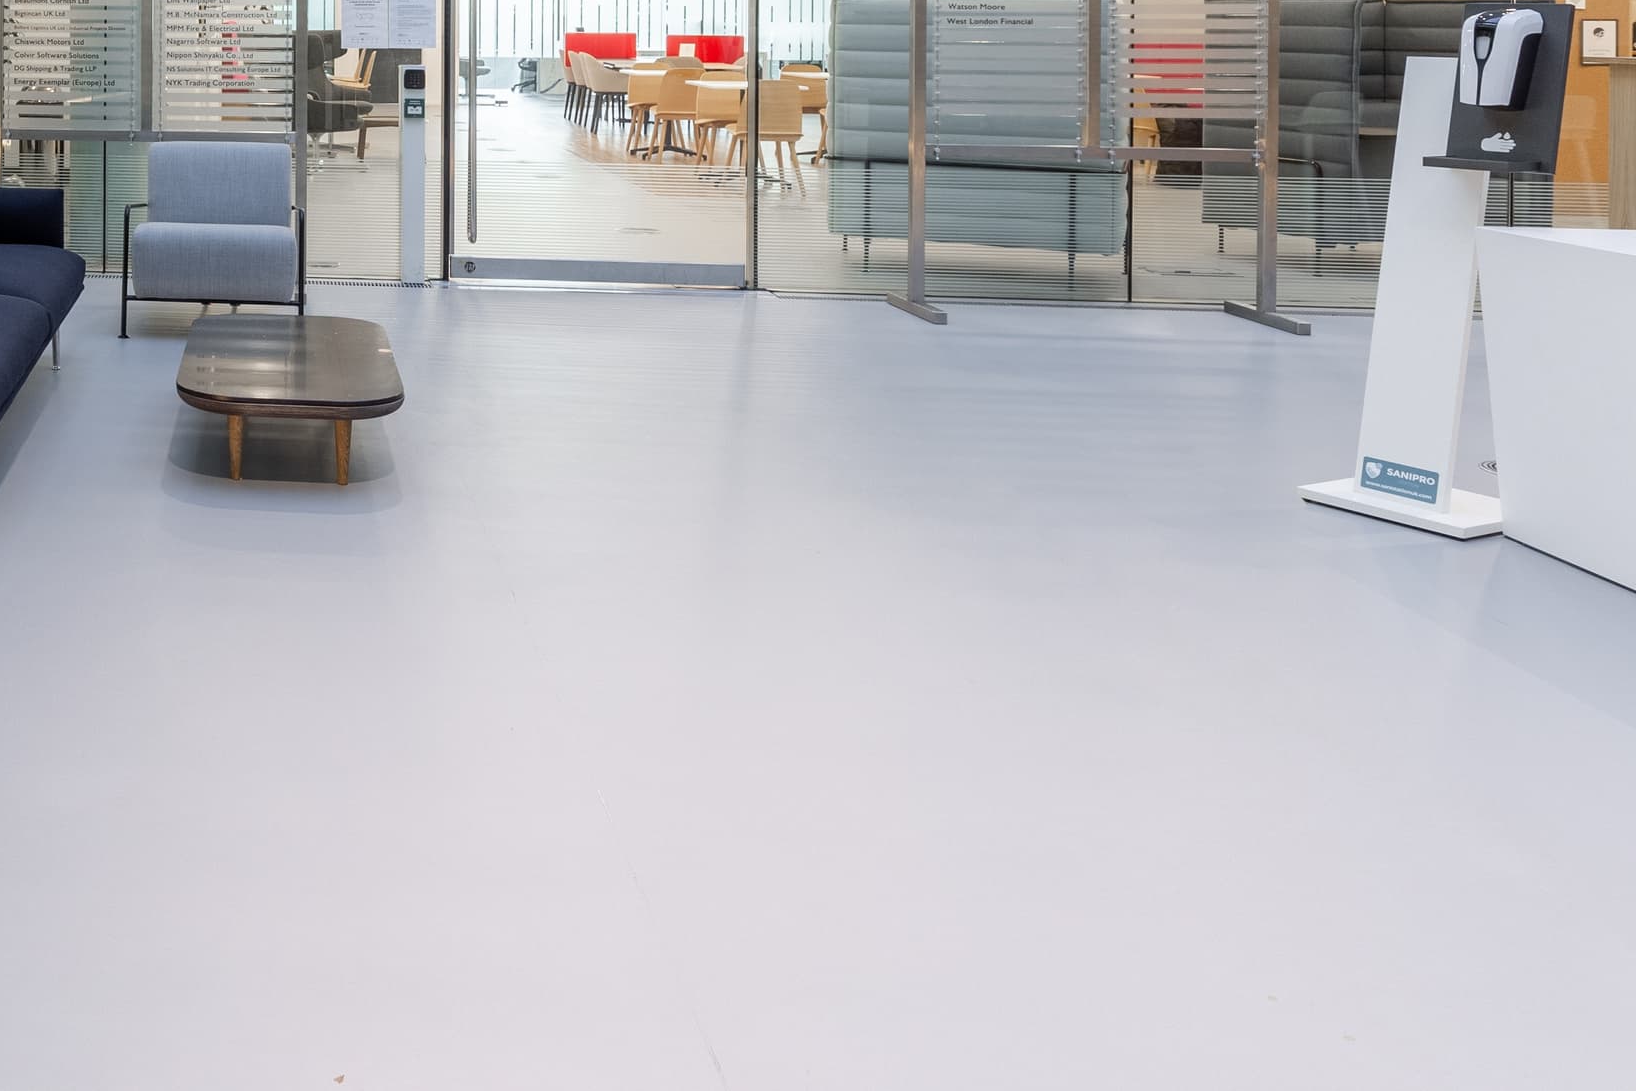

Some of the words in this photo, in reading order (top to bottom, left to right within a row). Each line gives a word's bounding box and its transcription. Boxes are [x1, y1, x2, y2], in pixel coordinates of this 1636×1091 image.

[14, 79, 37, 87] Energy
[39, 79, 70, 87] Exemplar
[72, 79, 102, 87] (Europe)
[1386, 468, 1435, 486] SANIPRO
